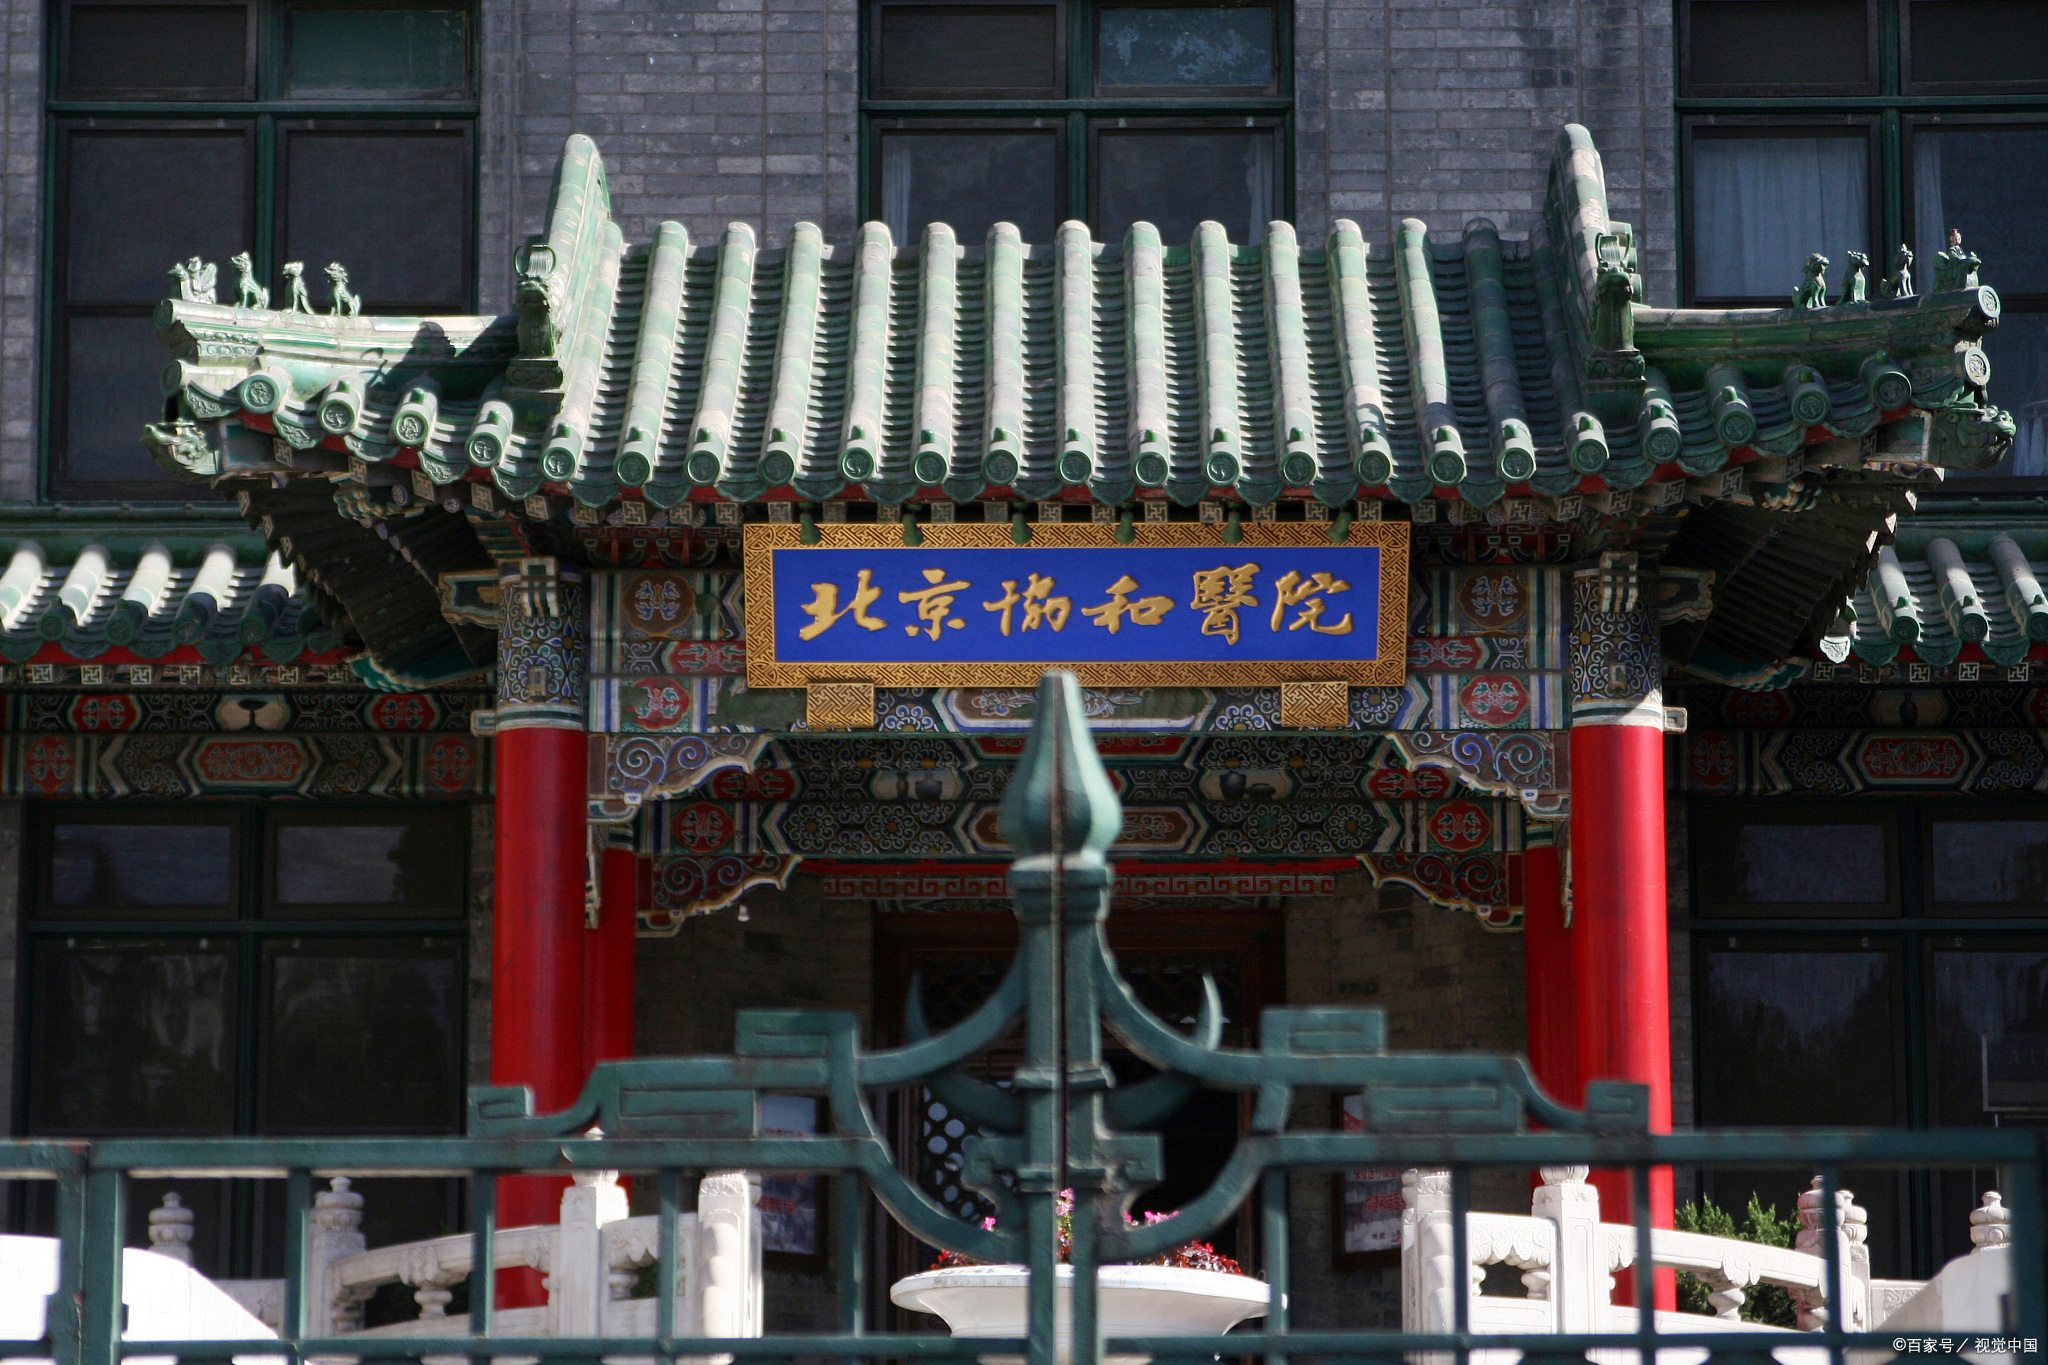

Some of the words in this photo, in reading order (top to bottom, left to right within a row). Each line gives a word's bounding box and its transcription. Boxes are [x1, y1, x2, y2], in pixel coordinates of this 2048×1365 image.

[799, 562, 1353, 645] 北京協和醫院
